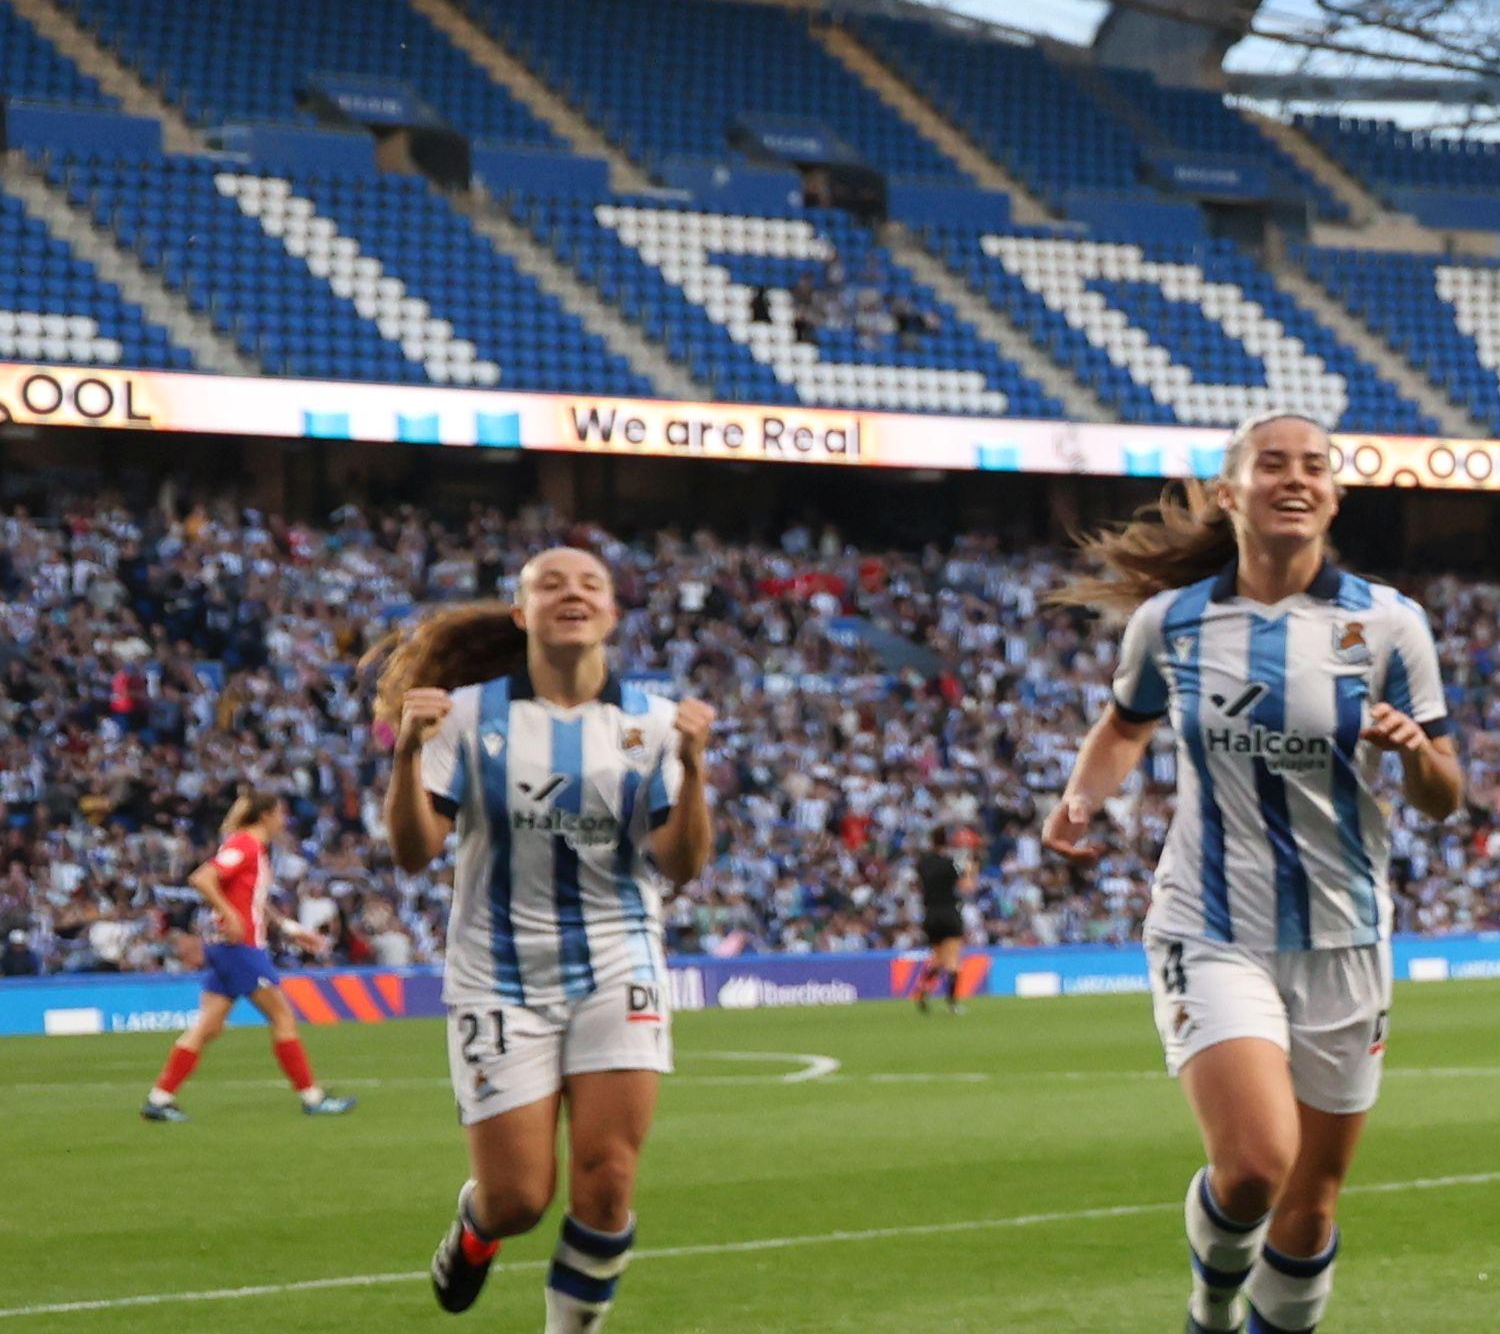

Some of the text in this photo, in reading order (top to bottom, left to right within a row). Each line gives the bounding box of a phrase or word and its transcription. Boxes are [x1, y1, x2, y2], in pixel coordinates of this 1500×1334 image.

[571, 407, 860, 454] We are Real
[1208, 726, 1330, 756] Halcón
[459, 1010, 506, 1064] 21
